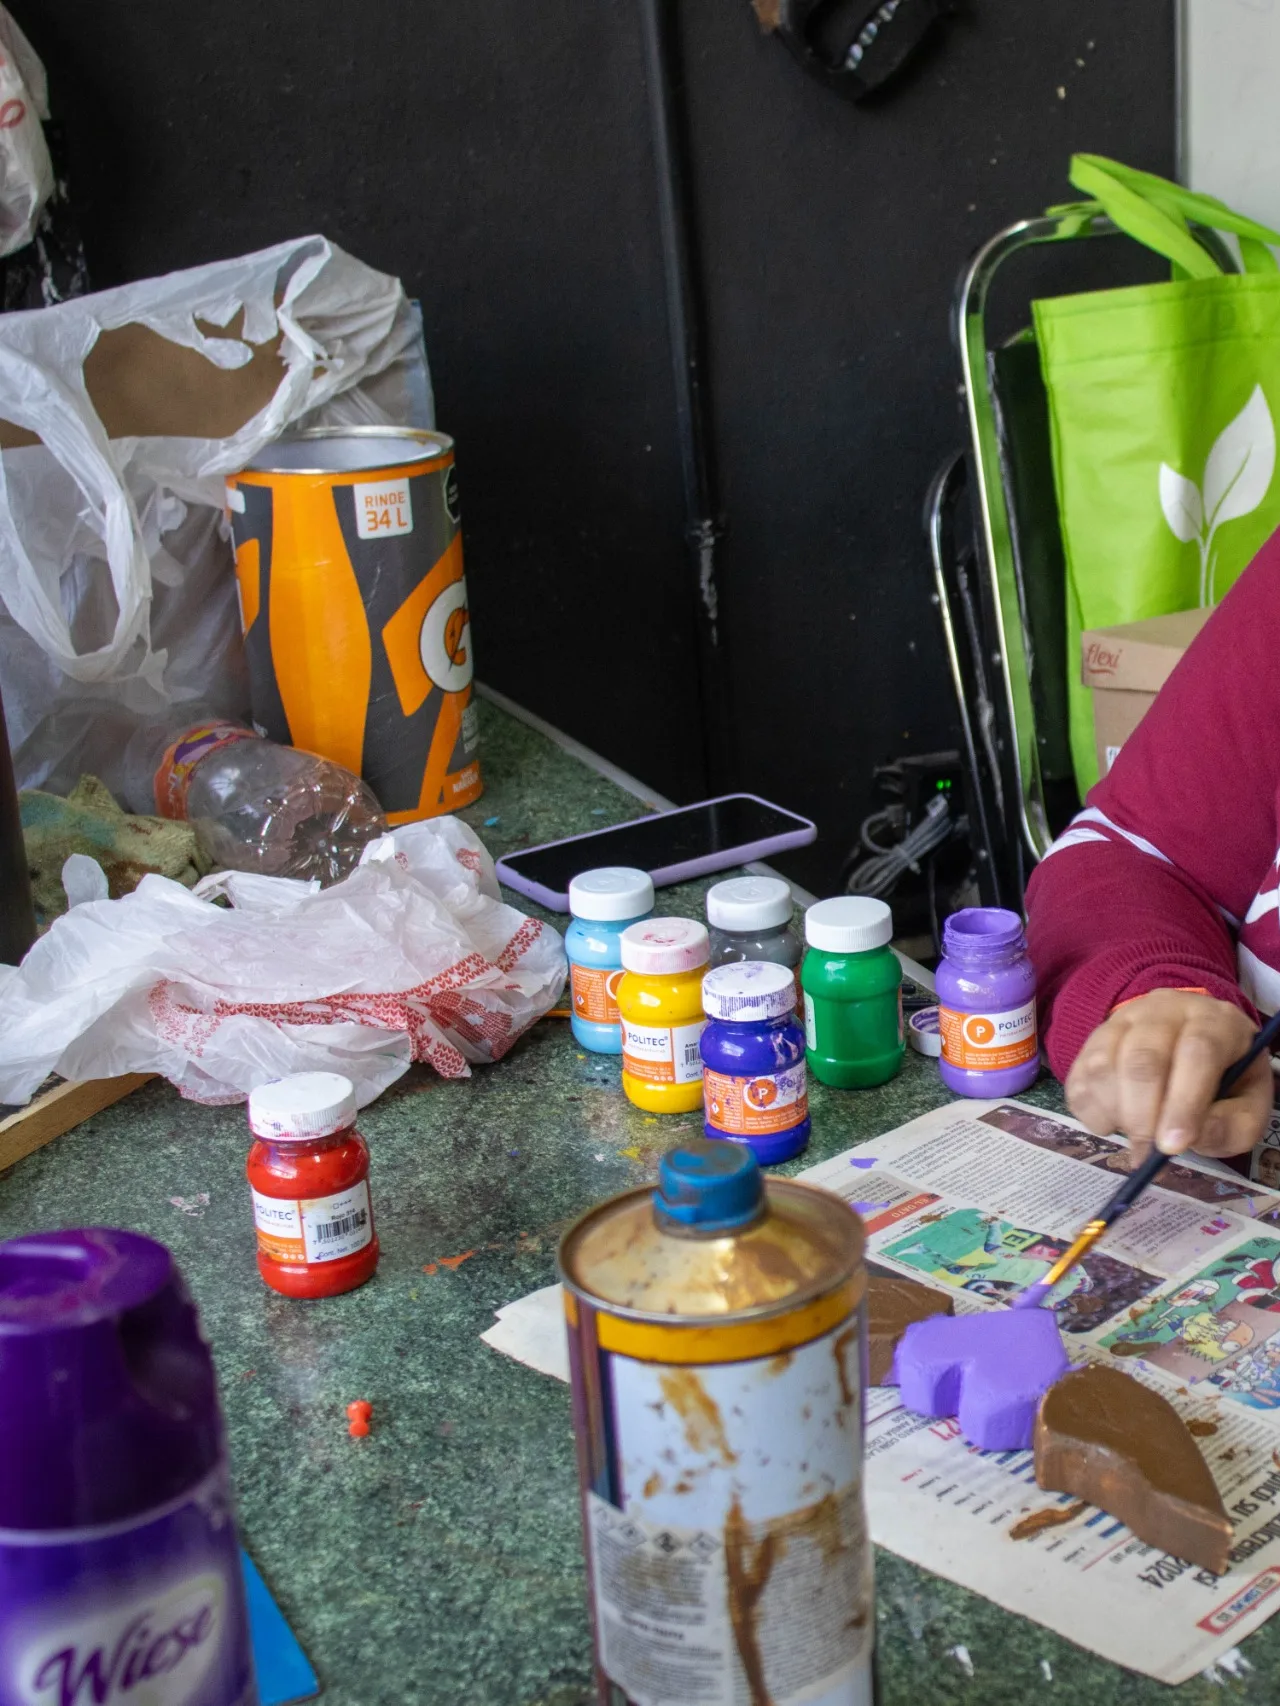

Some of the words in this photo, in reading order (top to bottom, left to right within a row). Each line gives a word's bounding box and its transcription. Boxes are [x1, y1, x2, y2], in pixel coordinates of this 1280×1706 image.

[364, 492, 406, 508] RINDE
[366, 508, 392, 531] 34
[396, 507, 408, 527] L
[1087, 643, 1123, 670] flexi
[998, 1012, 1033, 1031] POLITEC
[628, 1032, 666, 1046] POLITEC
[1136, 1554, 1191, 1590] 2024
